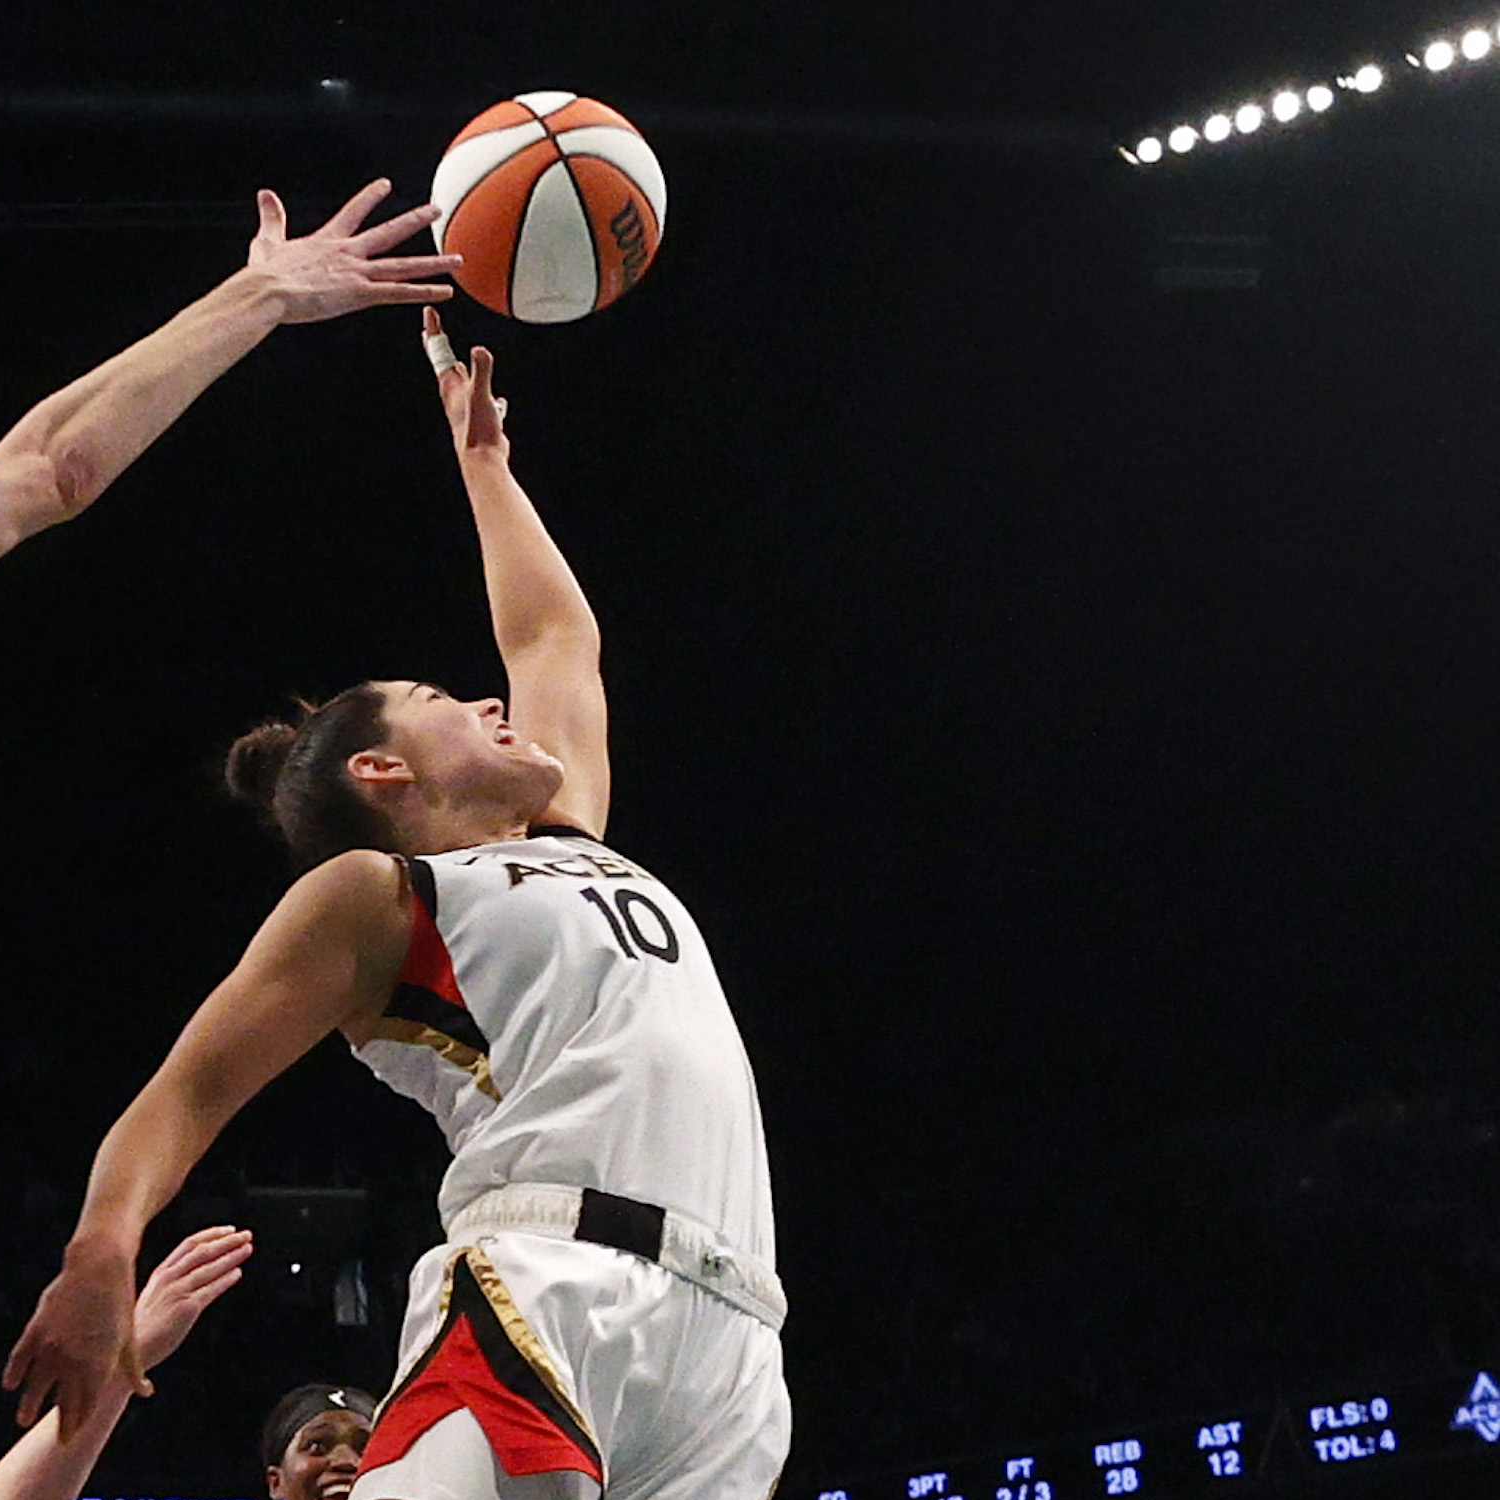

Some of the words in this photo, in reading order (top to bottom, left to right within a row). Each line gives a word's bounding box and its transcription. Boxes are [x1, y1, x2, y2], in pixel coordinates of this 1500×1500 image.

[580, 887, 679, 963] 10
[1198, 1421, 1242, 1448] AST
[1379, 1429, 1396, 1452] 4
[1094, 1440, 1141, 1467] REB
[1208, 1450, 1241, 1476] 12
[1006, 1457, 1034, 1482] FT
[1105, 1467, 1139, 1495] 28
[908, 1473, 947, 1499] 3PT
